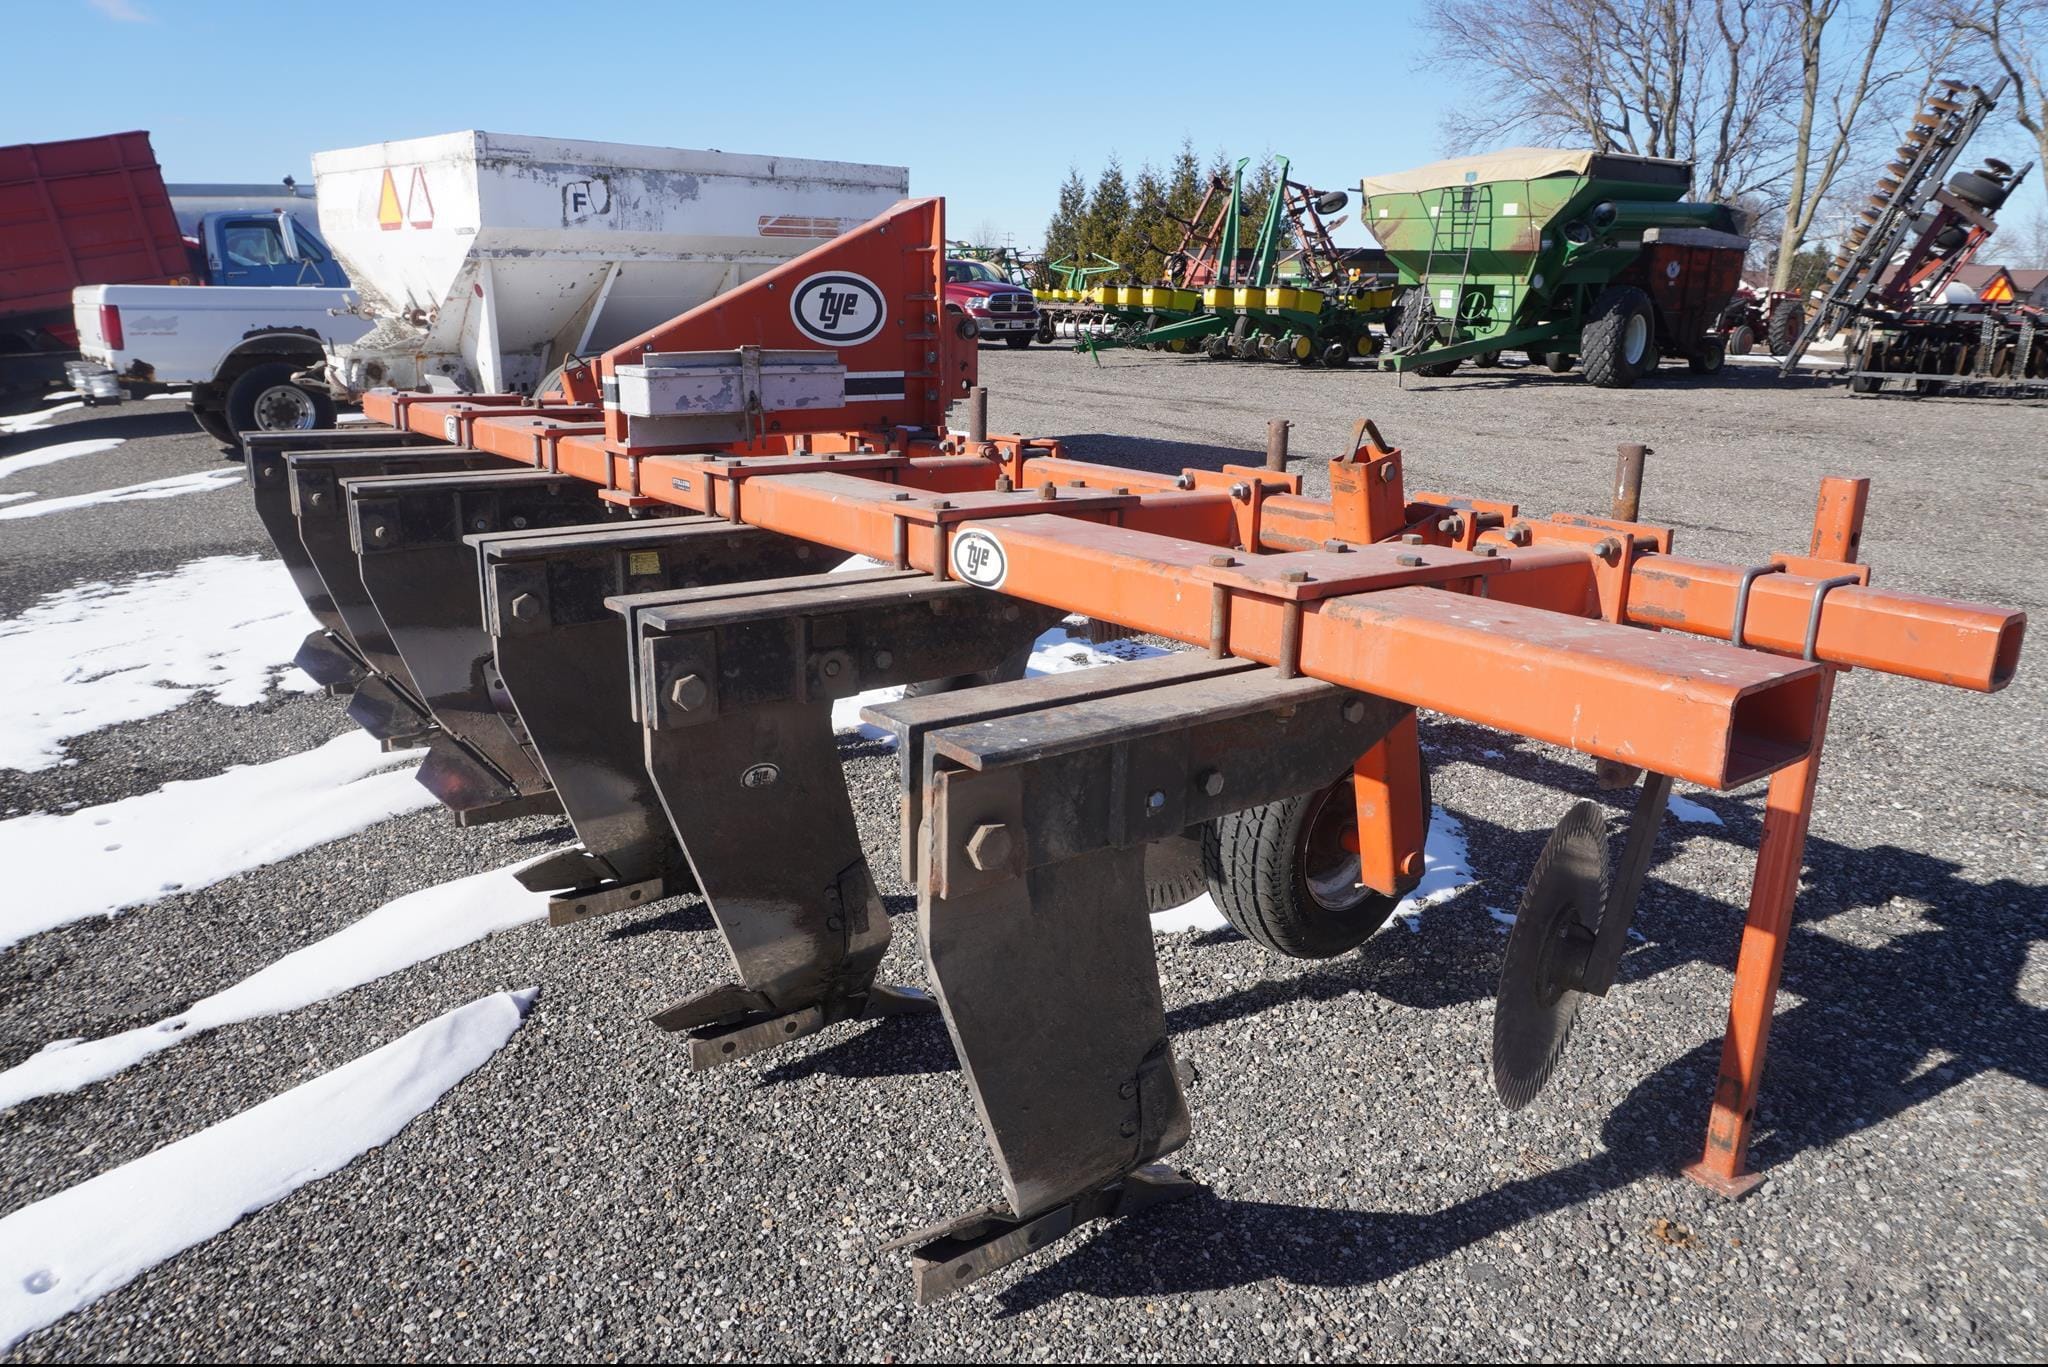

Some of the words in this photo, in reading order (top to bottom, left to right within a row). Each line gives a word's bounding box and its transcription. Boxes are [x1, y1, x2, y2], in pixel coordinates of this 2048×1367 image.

[573, 193, 587, 212] F
[819, 287, 859, 329] tye
[967, 541, 990, 576] tye
